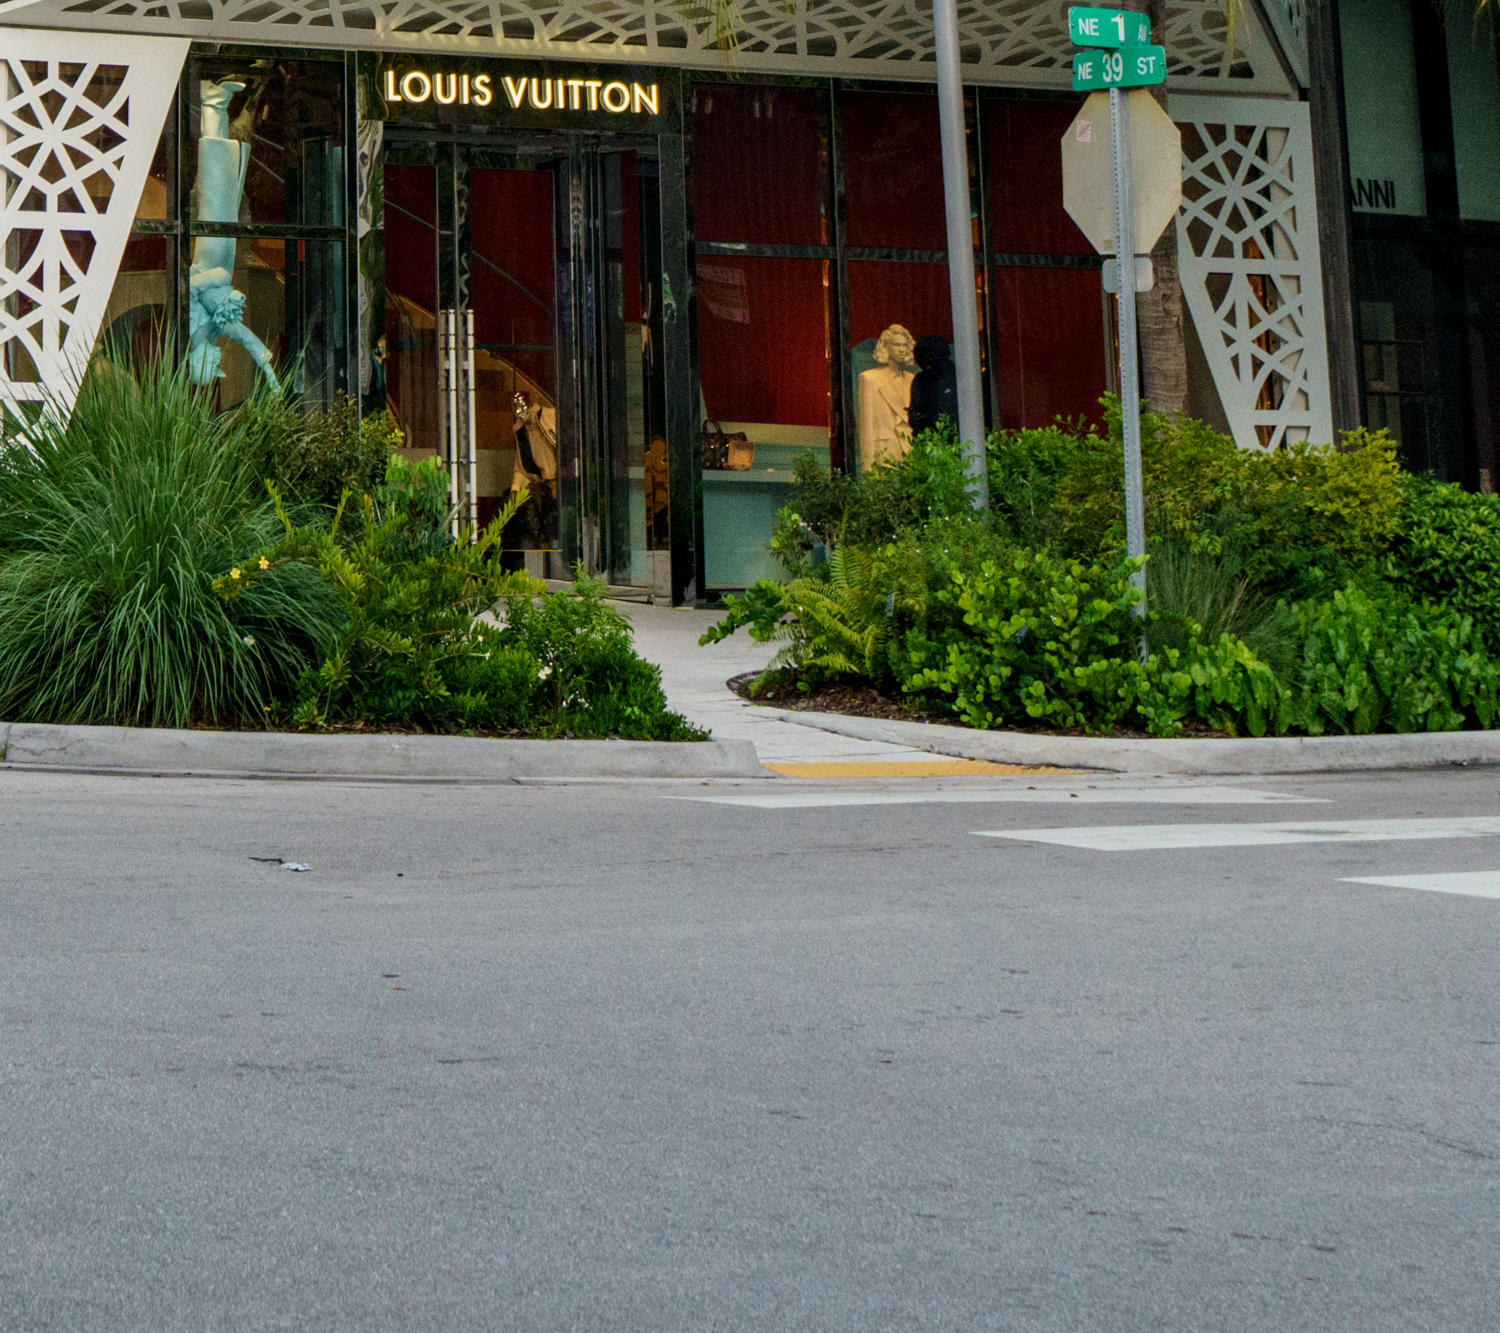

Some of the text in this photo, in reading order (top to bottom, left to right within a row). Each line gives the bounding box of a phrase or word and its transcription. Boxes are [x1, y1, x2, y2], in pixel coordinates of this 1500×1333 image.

[1078, 18, 1099, 36] NE
[1078, 52, 1156, 83] NE 39 ST
[384, 70, 660, 116] LOUIS VUITTON
